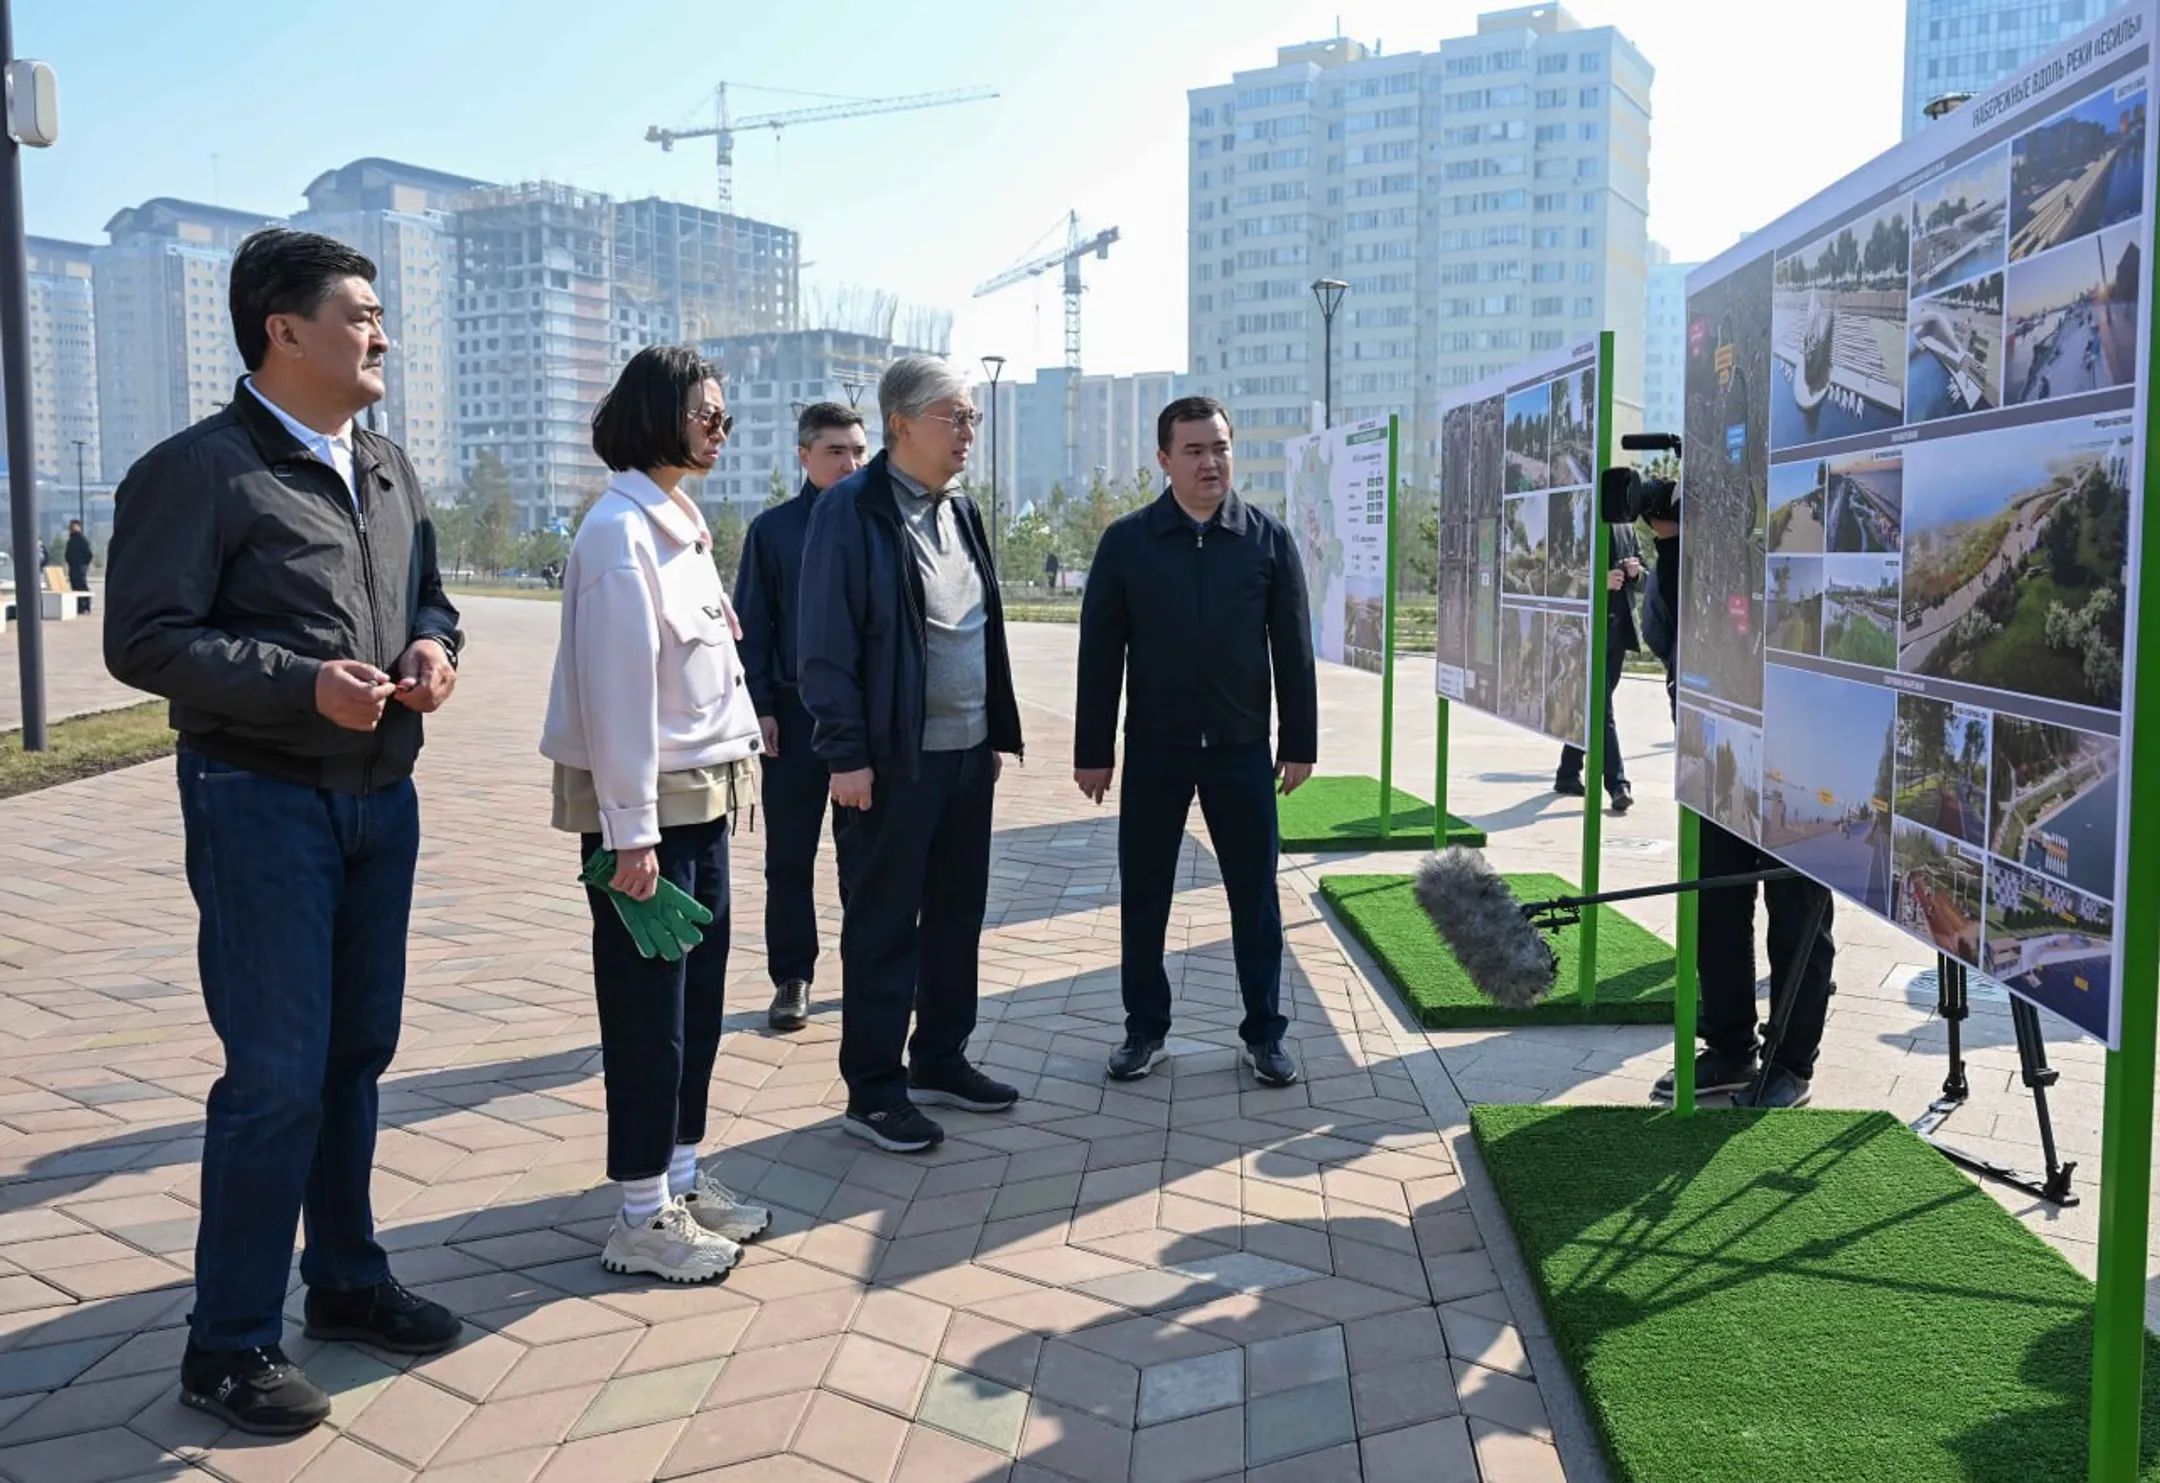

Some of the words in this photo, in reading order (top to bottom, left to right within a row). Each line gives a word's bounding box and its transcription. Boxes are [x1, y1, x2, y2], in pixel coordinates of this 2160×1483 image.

[1972, 77, 2030, 129] НАБЕРЕЖНЫЕ
[2031, 59, 2065, 95] ВДОЛЬ
[2066, 41, 2093, 75] РЕКИ
